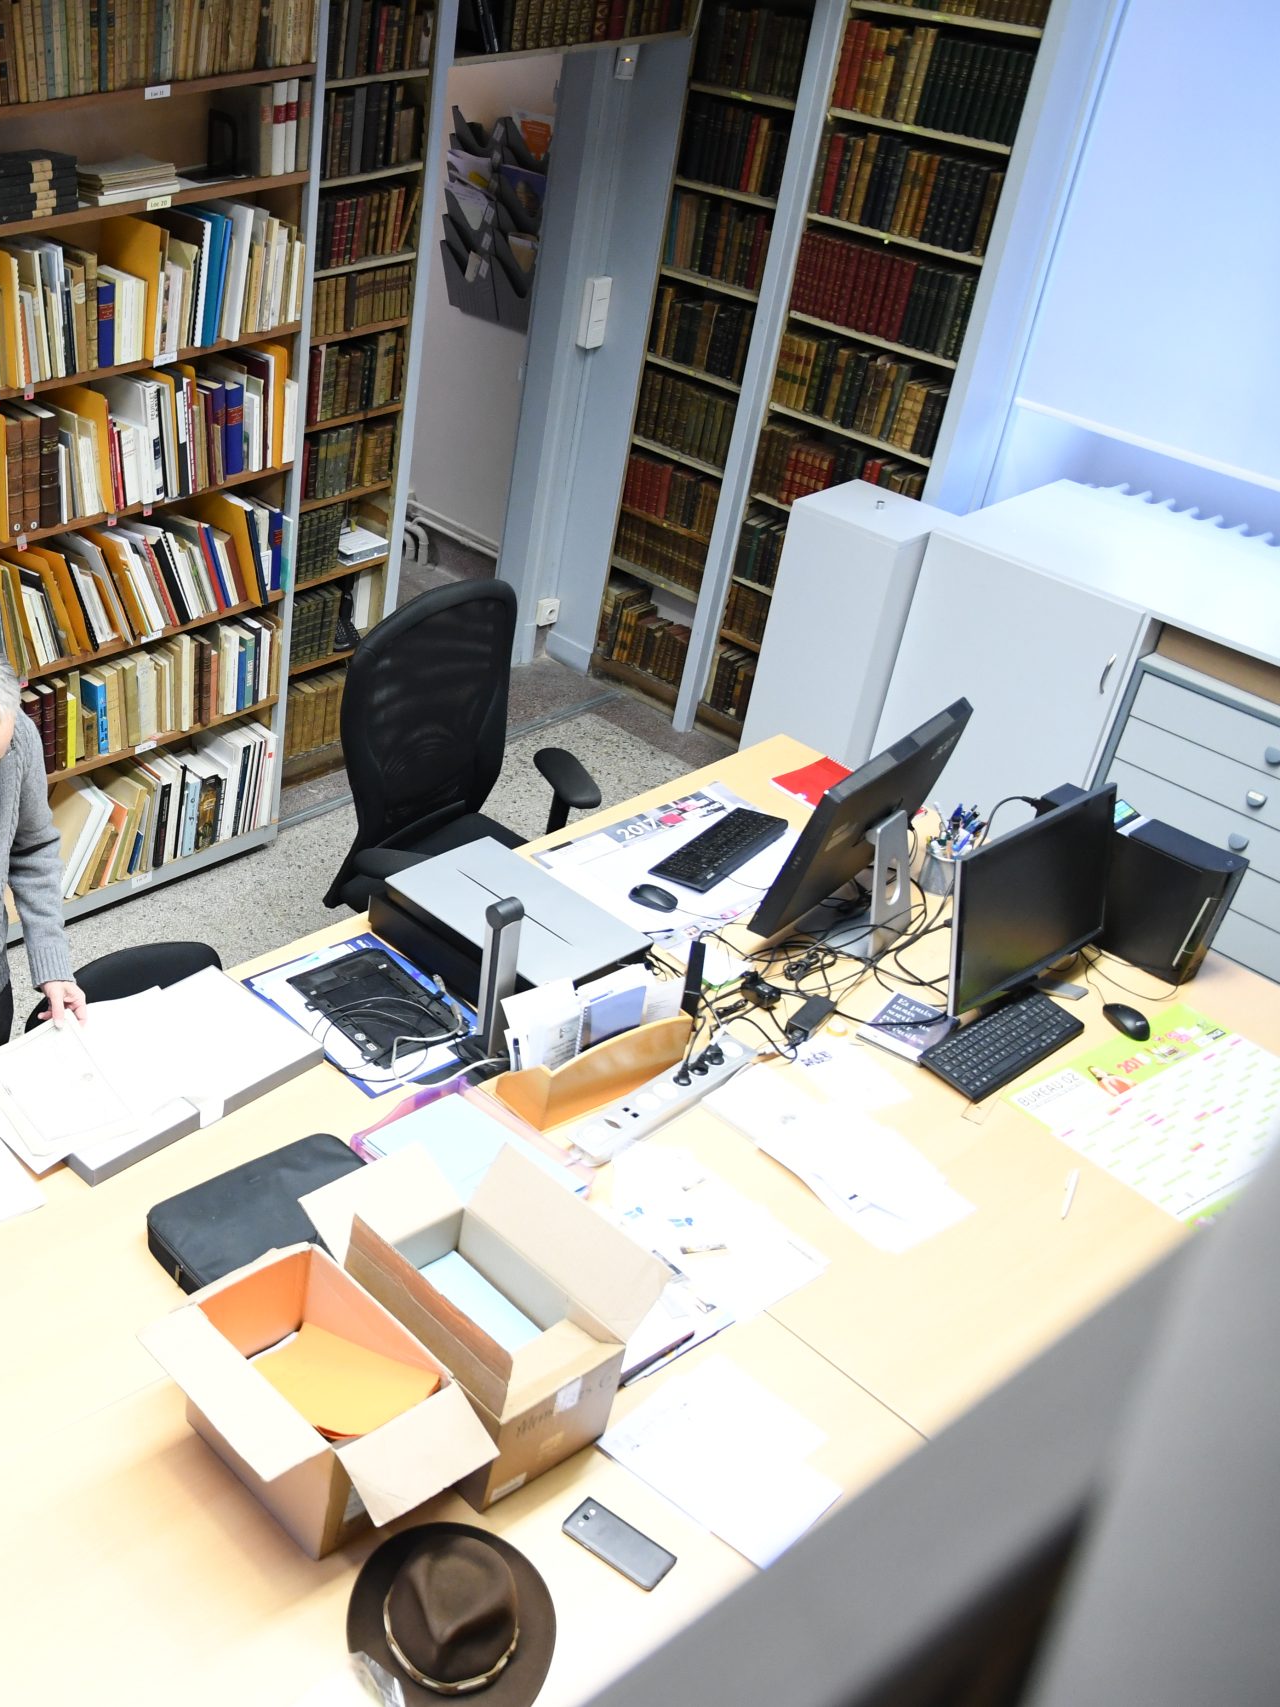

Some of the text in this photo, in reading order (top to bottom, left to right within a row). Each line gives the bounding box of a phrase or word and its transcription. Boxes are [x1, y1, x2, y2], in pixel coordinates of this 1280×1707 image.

[616, 817, 657, 842] 2017
[910, 1003, 933, 1018] puis
[1017, 1081, 1061, 1107] BUREAU
